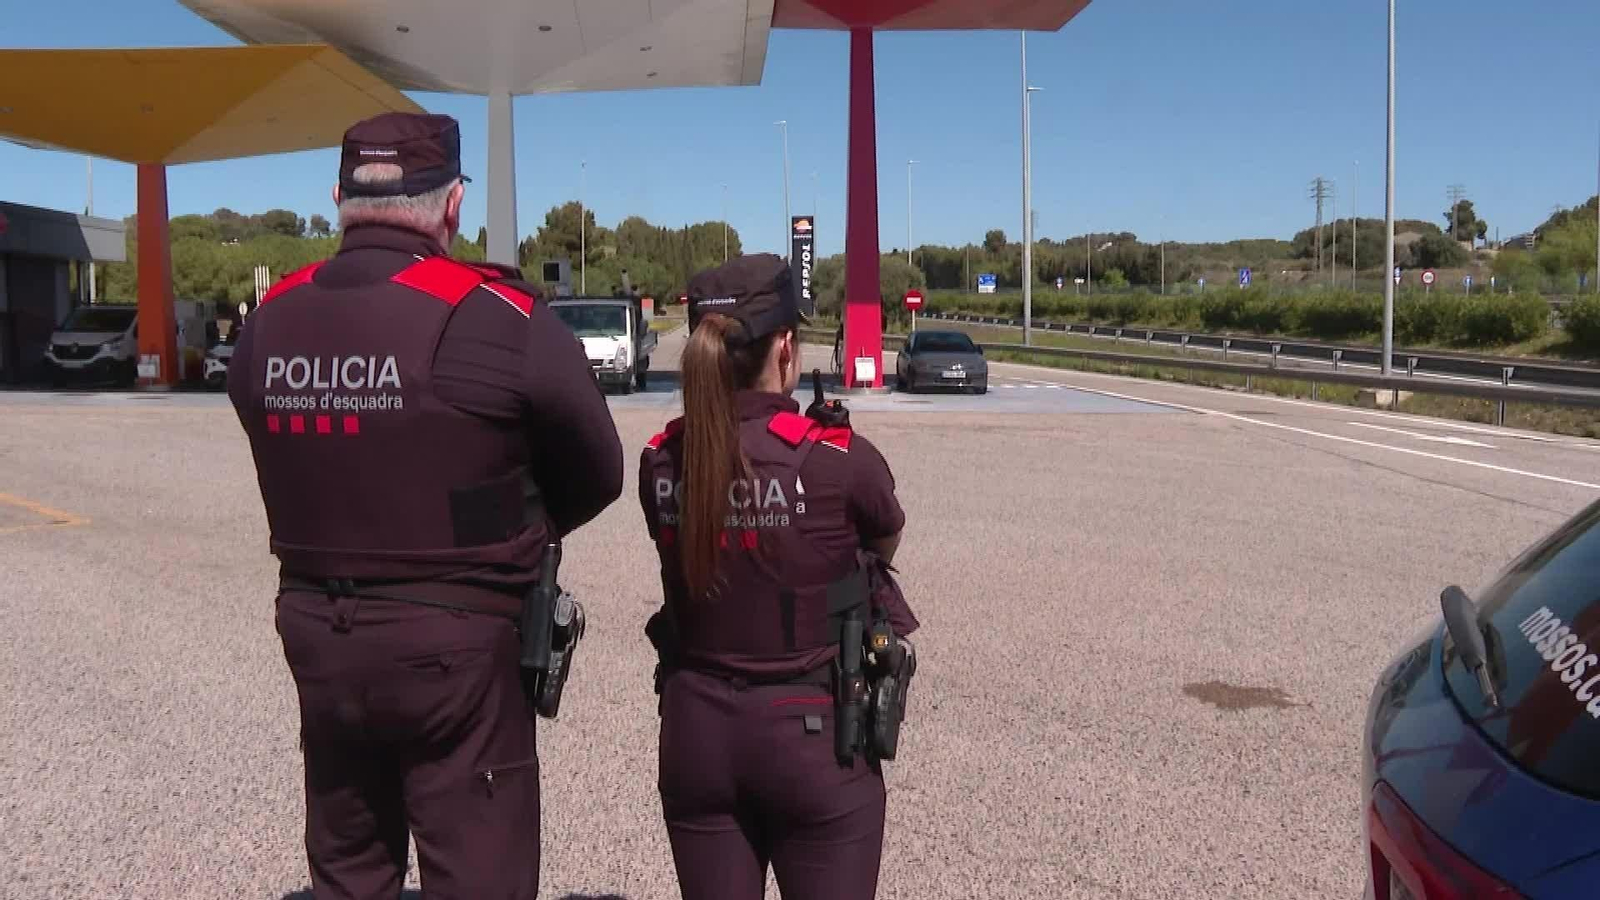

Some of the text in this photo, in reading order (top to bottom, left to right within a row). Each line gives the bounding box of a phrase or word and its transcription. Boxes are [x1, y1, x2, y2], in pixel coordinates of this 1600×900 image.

[802, 244, 811, 299] REPSOL
[264, 355, 401, 389] POLICIA
[264, 392, 403, 413] mossos d'esquadra
[655, 477, 788, 509] PCIA
